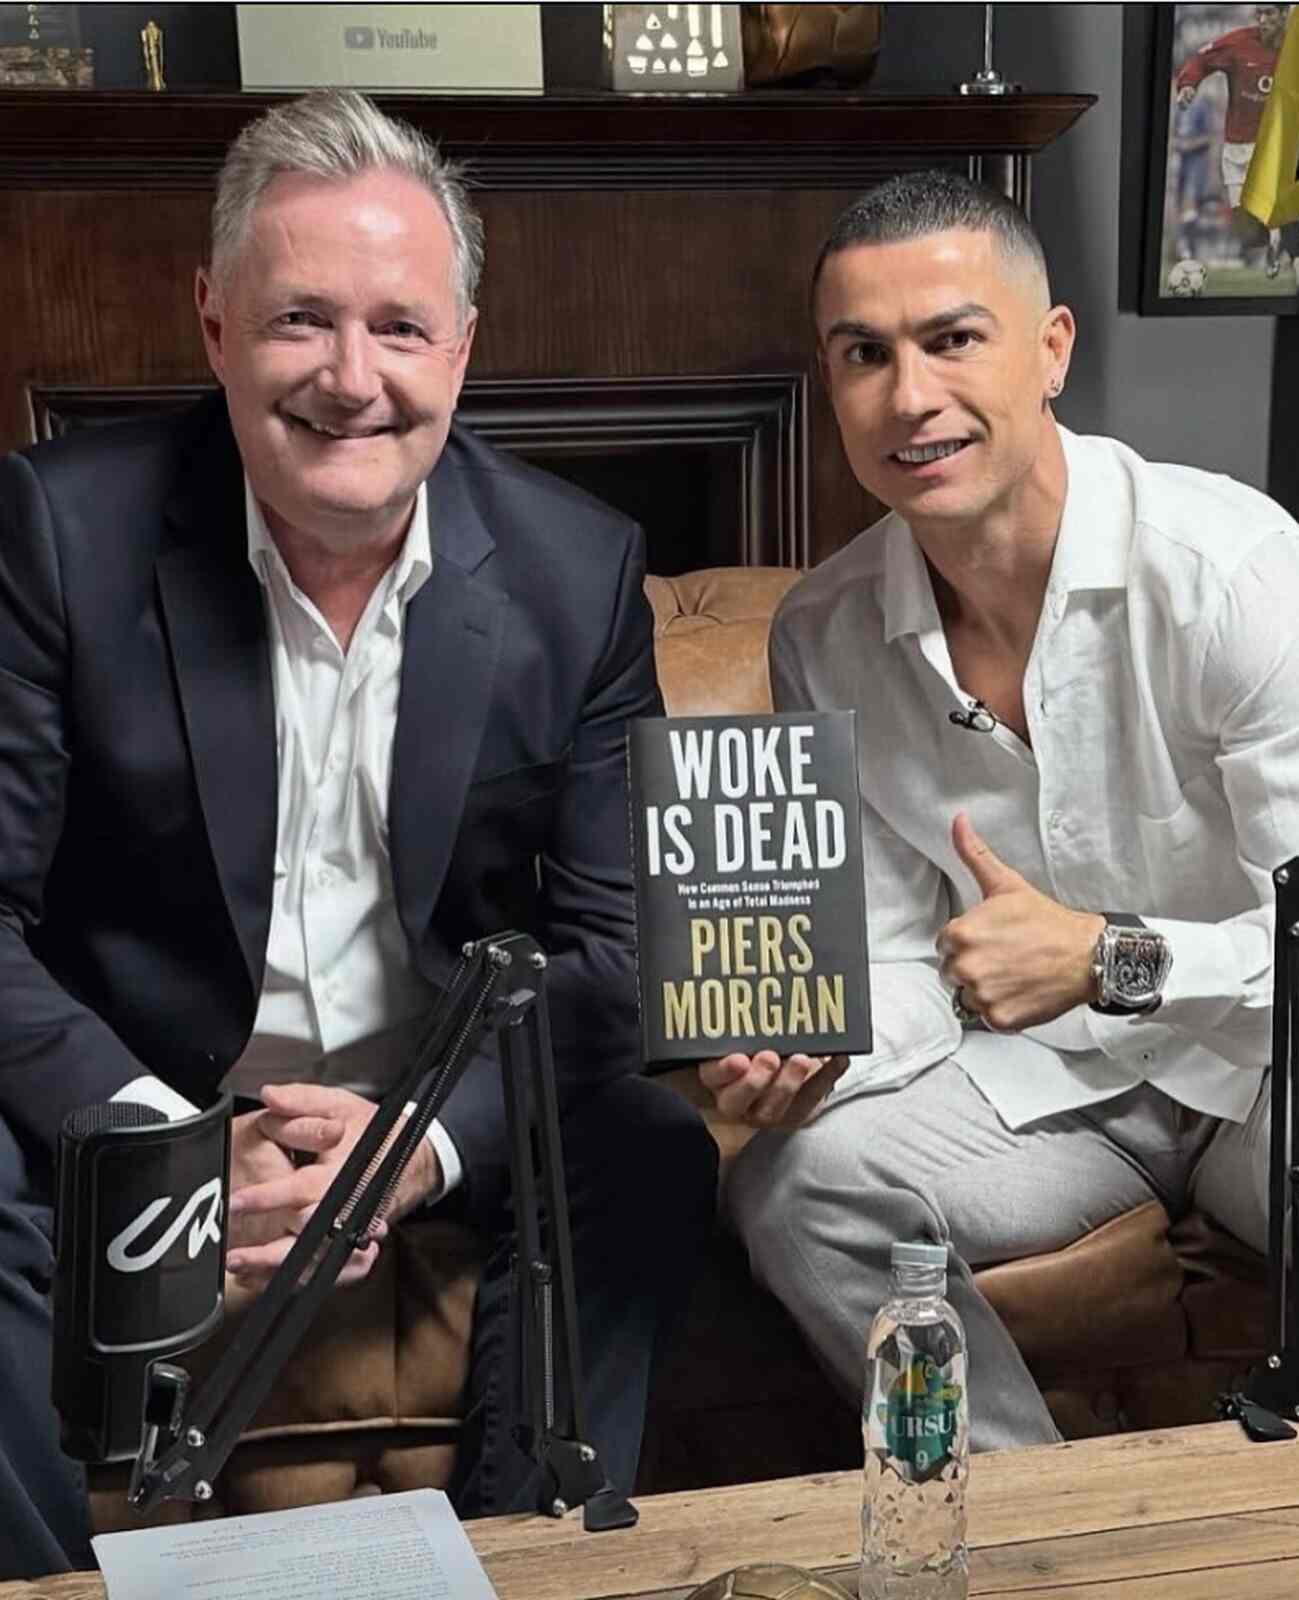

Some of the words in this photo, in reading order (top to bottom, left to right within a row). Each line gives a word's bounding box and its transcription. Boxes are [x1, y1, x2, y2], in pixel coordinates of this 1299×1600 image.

[376, 27, 438, 50] YouTube
[669, 726, 818, 799] WOKE
[646, 804, 695, 876] IS
[714, 800, 846, 873] DEAD
[677, 882, 699, 896] How
[700, 882, 740, 895] Common
[741, 879, 771, 893] Sense
[772, 878, 820, 893] Triumphed
[699, 899, 711, 909] an
[712, 897, 731, 910] Age
[732, 896, 743, 908] of
[743, 895, 768, 908] Total
[769, 895, 811, 907] Madness
[690, 914, 814, 977] PIERS
[662, 974, 846, 1040] MORGAN
[915, 1449, 929, 1472] 9
